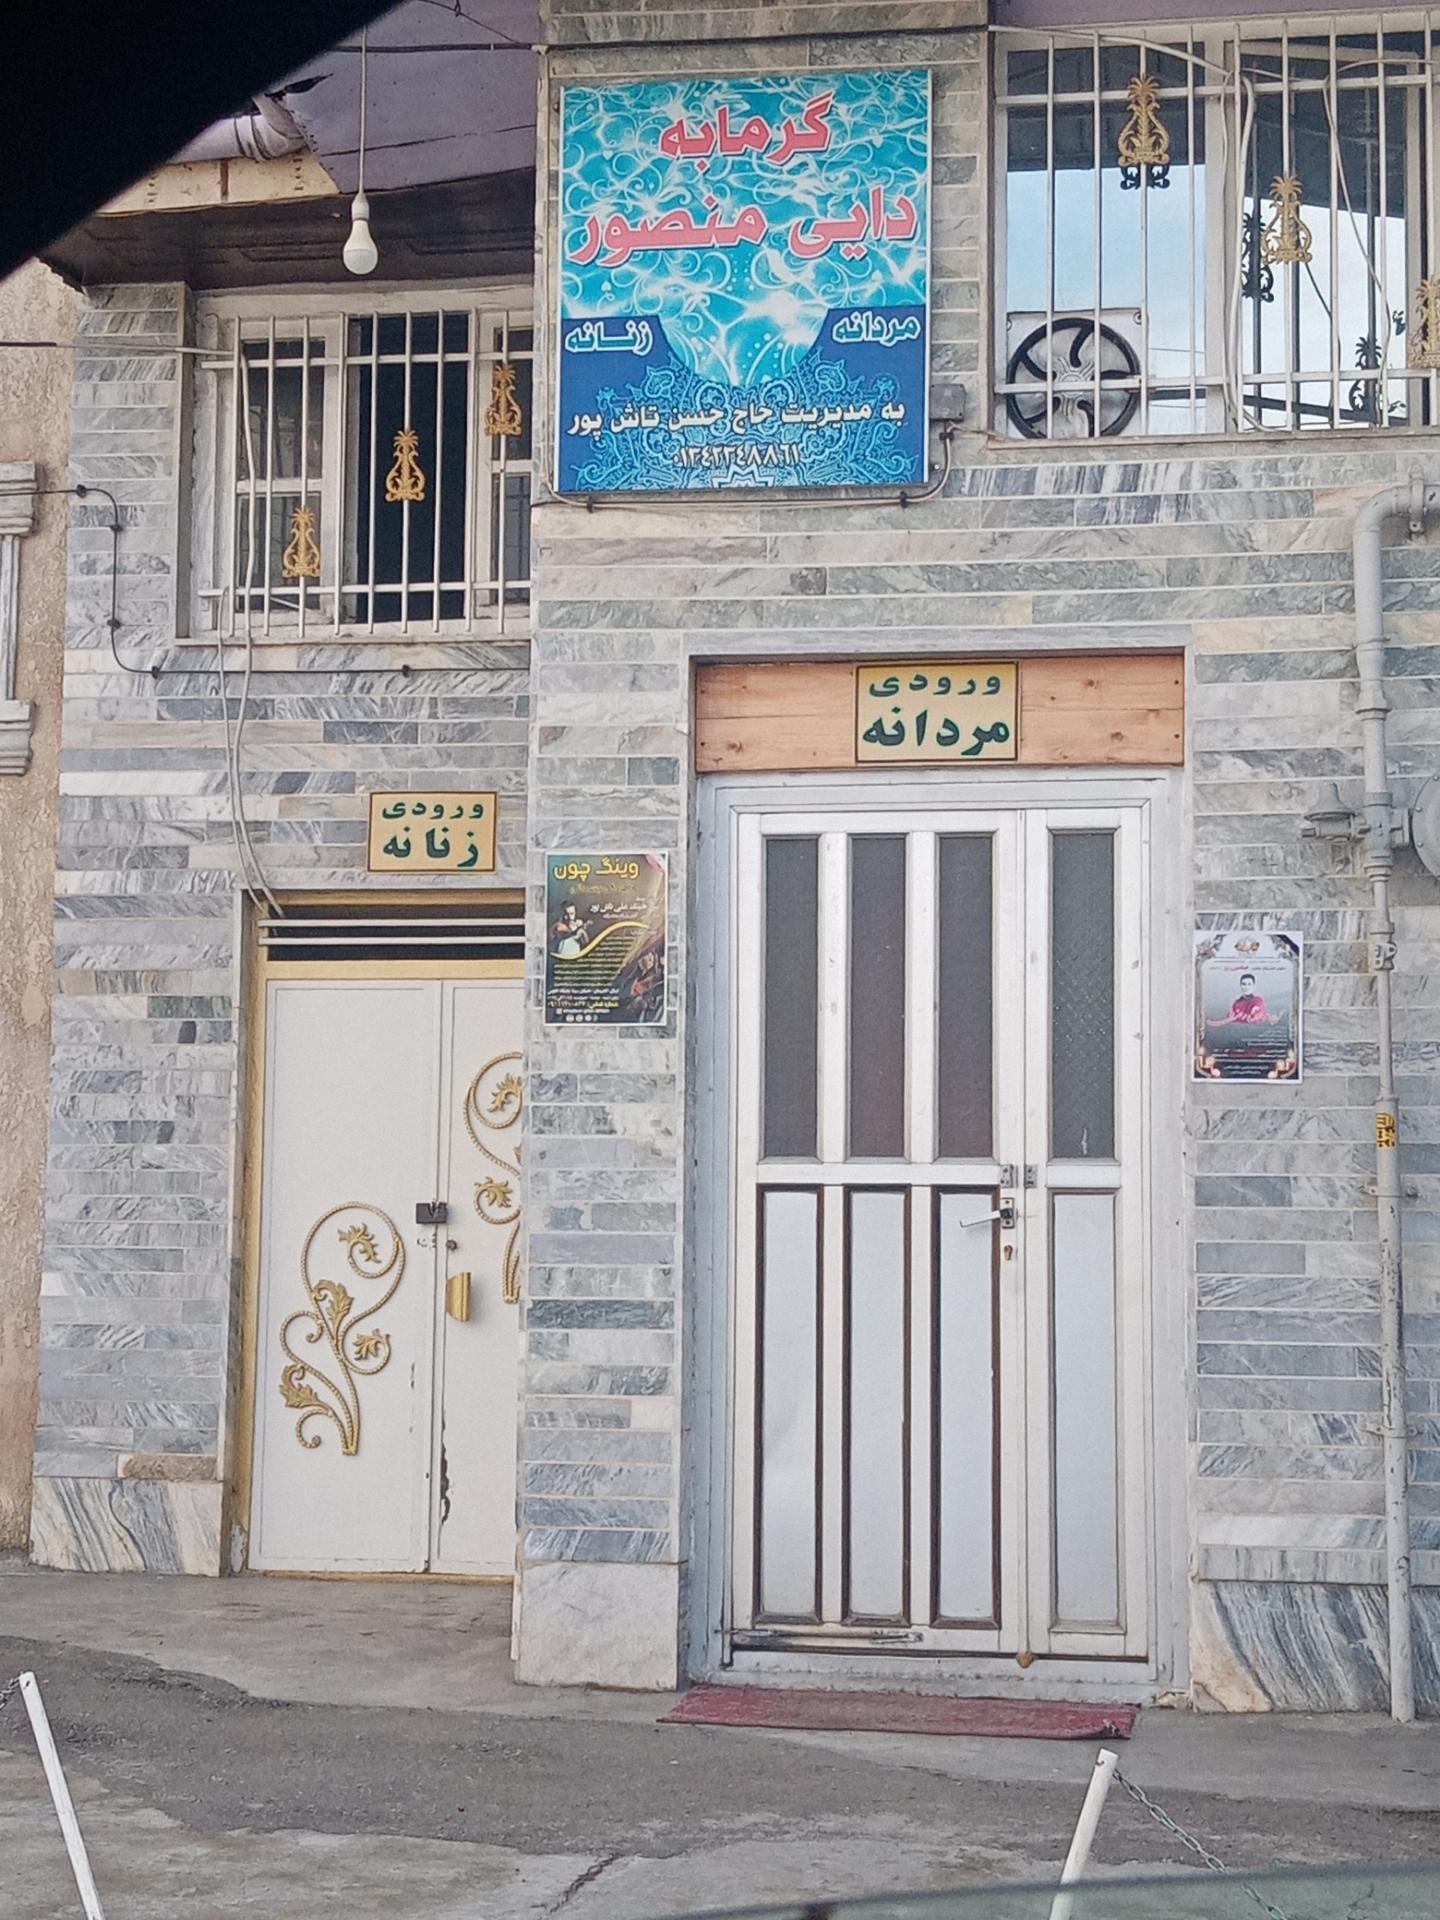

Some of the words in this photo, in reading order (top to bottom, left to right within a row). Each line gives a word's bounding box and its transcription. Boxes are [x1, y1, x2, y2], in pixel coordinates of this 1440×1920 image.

[659, 91, 833, 174] گرمابه
[569, 194, 768, 266] منصور
[788, 187, 917, 260] دایی
[833, 311, 920, 344] مردانه
[567, 413, 602, 441] پور
[610, 403, 660, 433] تاش
[669, 407, 724, 431] حسن
[732, 402, 774, 435] حاج
[781, 402, 873, 429] مدیریت
[881, 402, 905, 426] به
[869, 674, 1001, 697] ورودی
[862, 707, 1010, 756] مردانه
[382, 802, 484, 819] ورودی
[383, 826, 479, 867] زنانه
